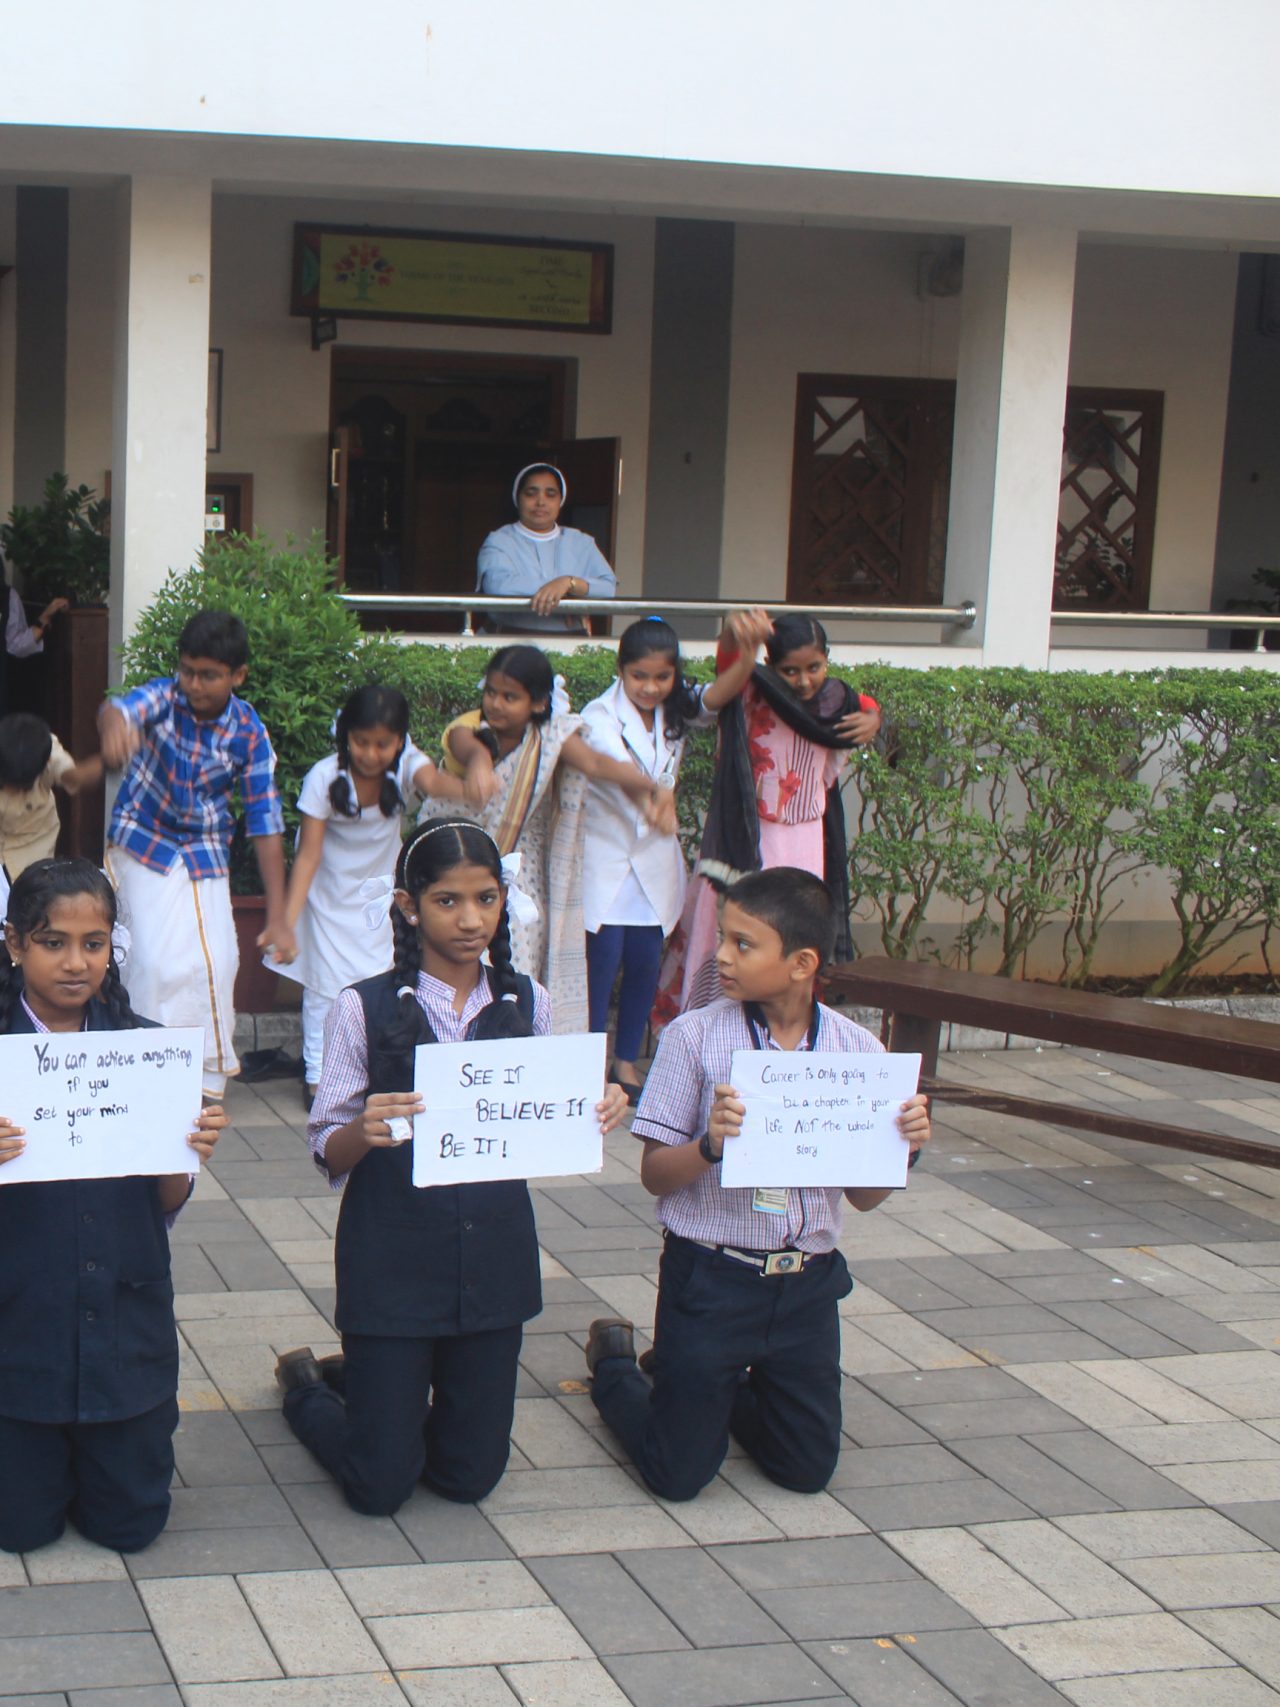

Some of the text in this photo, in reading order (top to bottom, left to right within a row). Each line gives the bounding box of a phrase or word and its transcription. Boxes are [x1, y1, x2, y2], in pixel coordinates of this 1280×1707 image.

[34, 1042, 193, 1076] You can achieve anything
[460, 1062, 526, 1088] SEE IT
[761, 1065, 890, 1085] Cancer is only going to
[67, 1076, 110, 1098] if you
[476, 1097, 588, 1123] BELIEVE IT
[802, 1099, 810, 1107] a
[815, 1096, 850, 1109] chapter
[857, 1095, 867, 1106] in
[871, 1098, 891, 1112] your
[67, 1107, 95, 1127] your
[100, 1103, 129, 1118] mind
[765, 1117, 783, 1134] life
[822, 1119, 842, 1132] the
[848, 1119, 875, 1132] whole
[68, 1130, 83, 1147] to
[439, 1133, 466, 1159] BE
[796, 1144, 819, 1158] story
